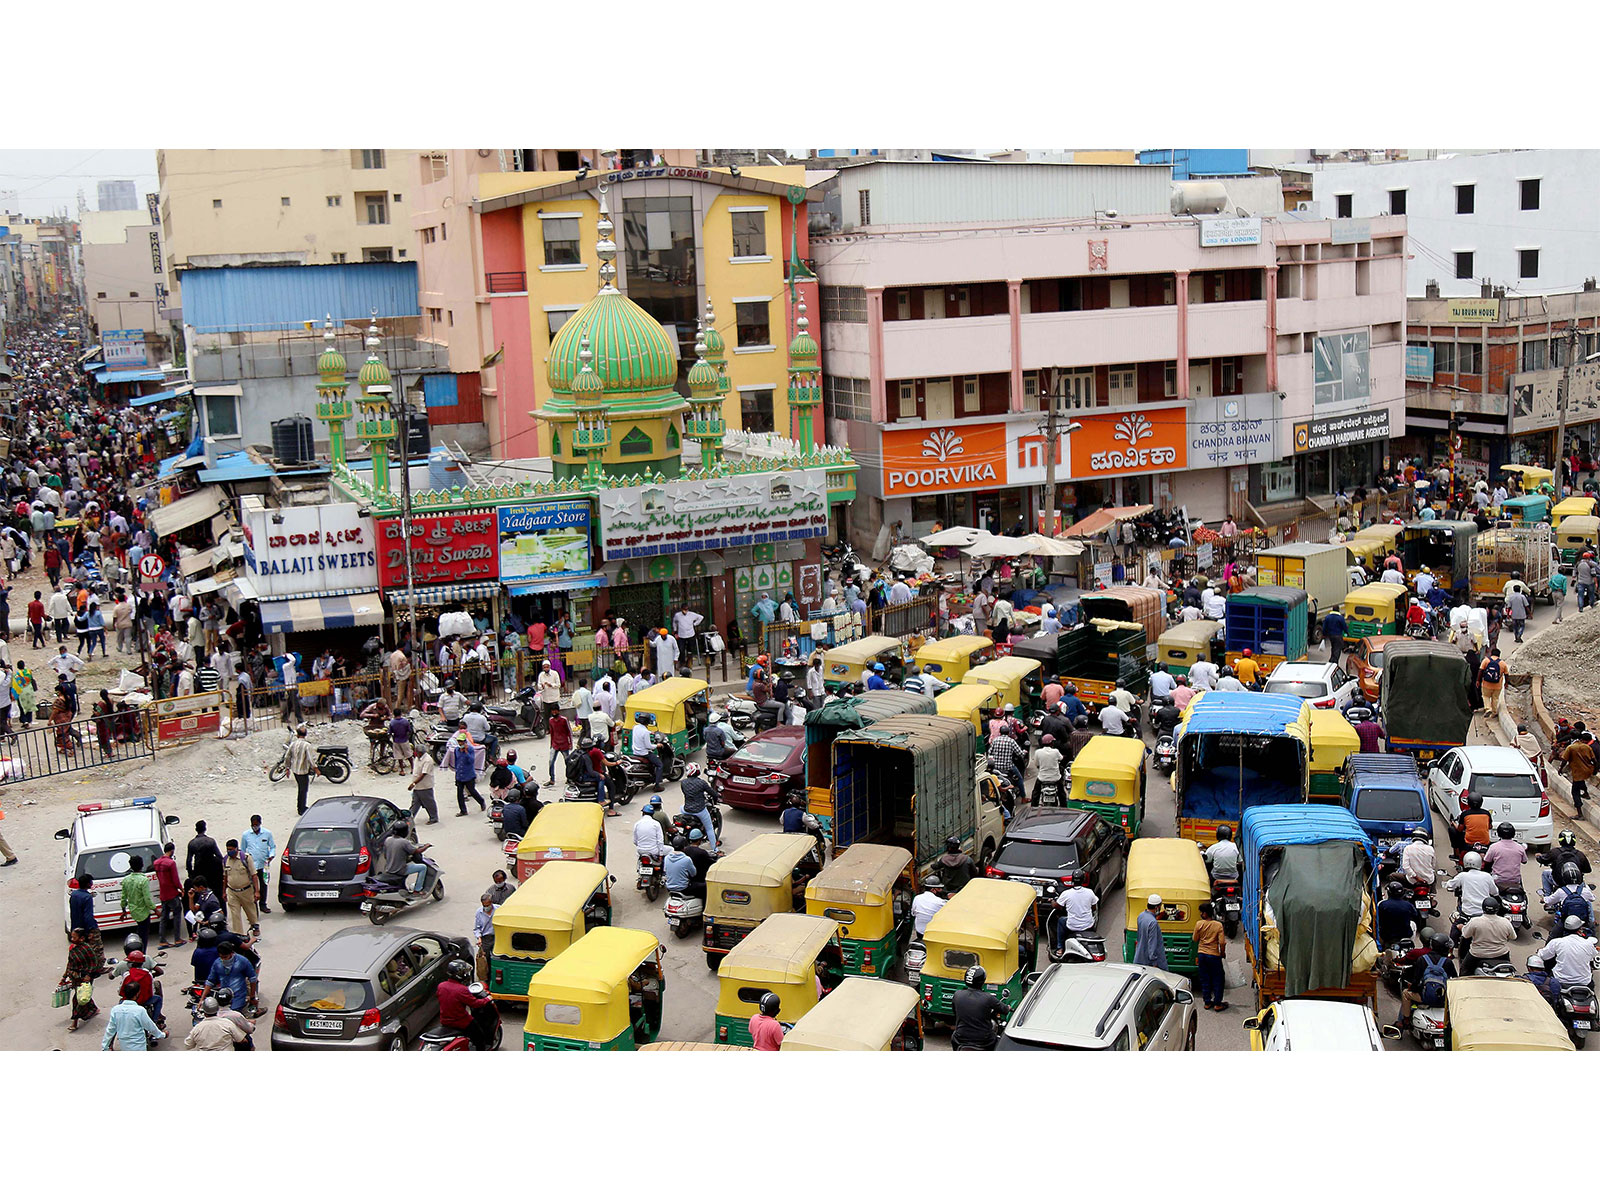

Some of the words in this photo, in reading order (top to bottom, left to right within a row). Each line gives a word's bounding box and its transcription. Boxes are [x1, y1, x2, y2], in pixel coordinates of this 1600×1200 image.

[668, 168, 710, 179] LODGING
[150, 232, 162, 273] CHANDRA
[1452, 308, 1461, 316] TAJ
[1462, 308, 1478, 316] BRUSH
[1479, 308, 1495, 316] HOUSE
[1192, 437, 1234, 450] CHANDRA
[1236, 433, 1271, 446] BHAVAN
[1308, 434, 1335, 448] CHANDRA
[1335, 429, 1365, 444] HARDWARE
[1365, 425, 1390, 439] AGENCIES
[889, 463, 997, 489] POORVIKA
[510, 507, 525, 515] Fresh
[542, 504, 557, 512] Cane
[557, 503, 571, 512] Juice
[502, 512, 554, 530] Yadgaar
[554, 511, 586, 525] Store
[260, 556, 314, 576] BALAJI
[318, 551, 375, 571] SWEETS
[387, 547, 435, 568] Dlhi
[438, 543, 493, 564] Sweets
